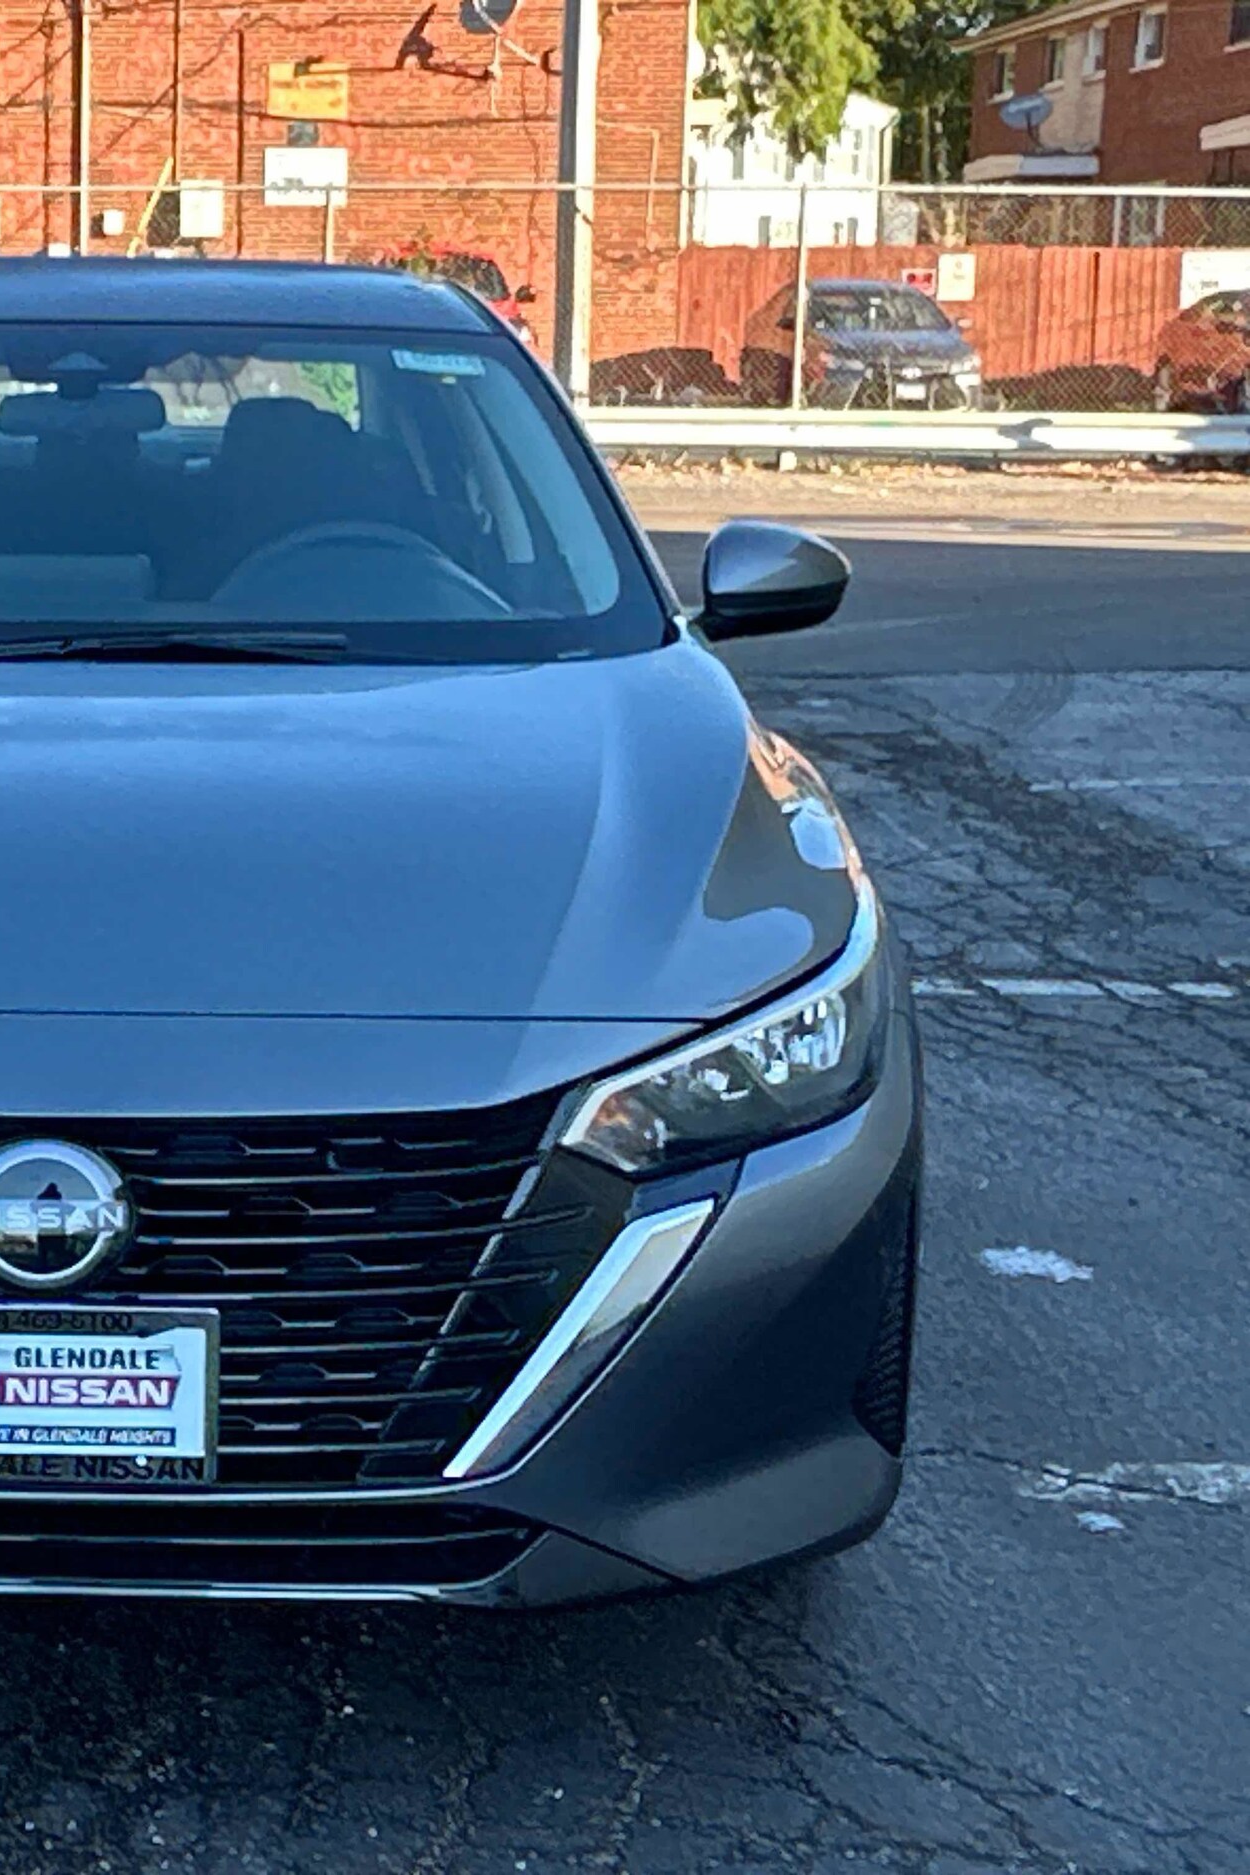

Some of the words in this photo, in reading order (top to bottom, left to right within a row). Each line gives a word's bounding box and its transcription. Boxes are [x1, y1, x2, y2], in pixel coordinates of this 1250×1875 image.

[14, 1346, 160, 1370] GLENDALE
[4, 1376, 170, 1406] NISSAN
[74, 1456, 205, 1480] NISSAN
